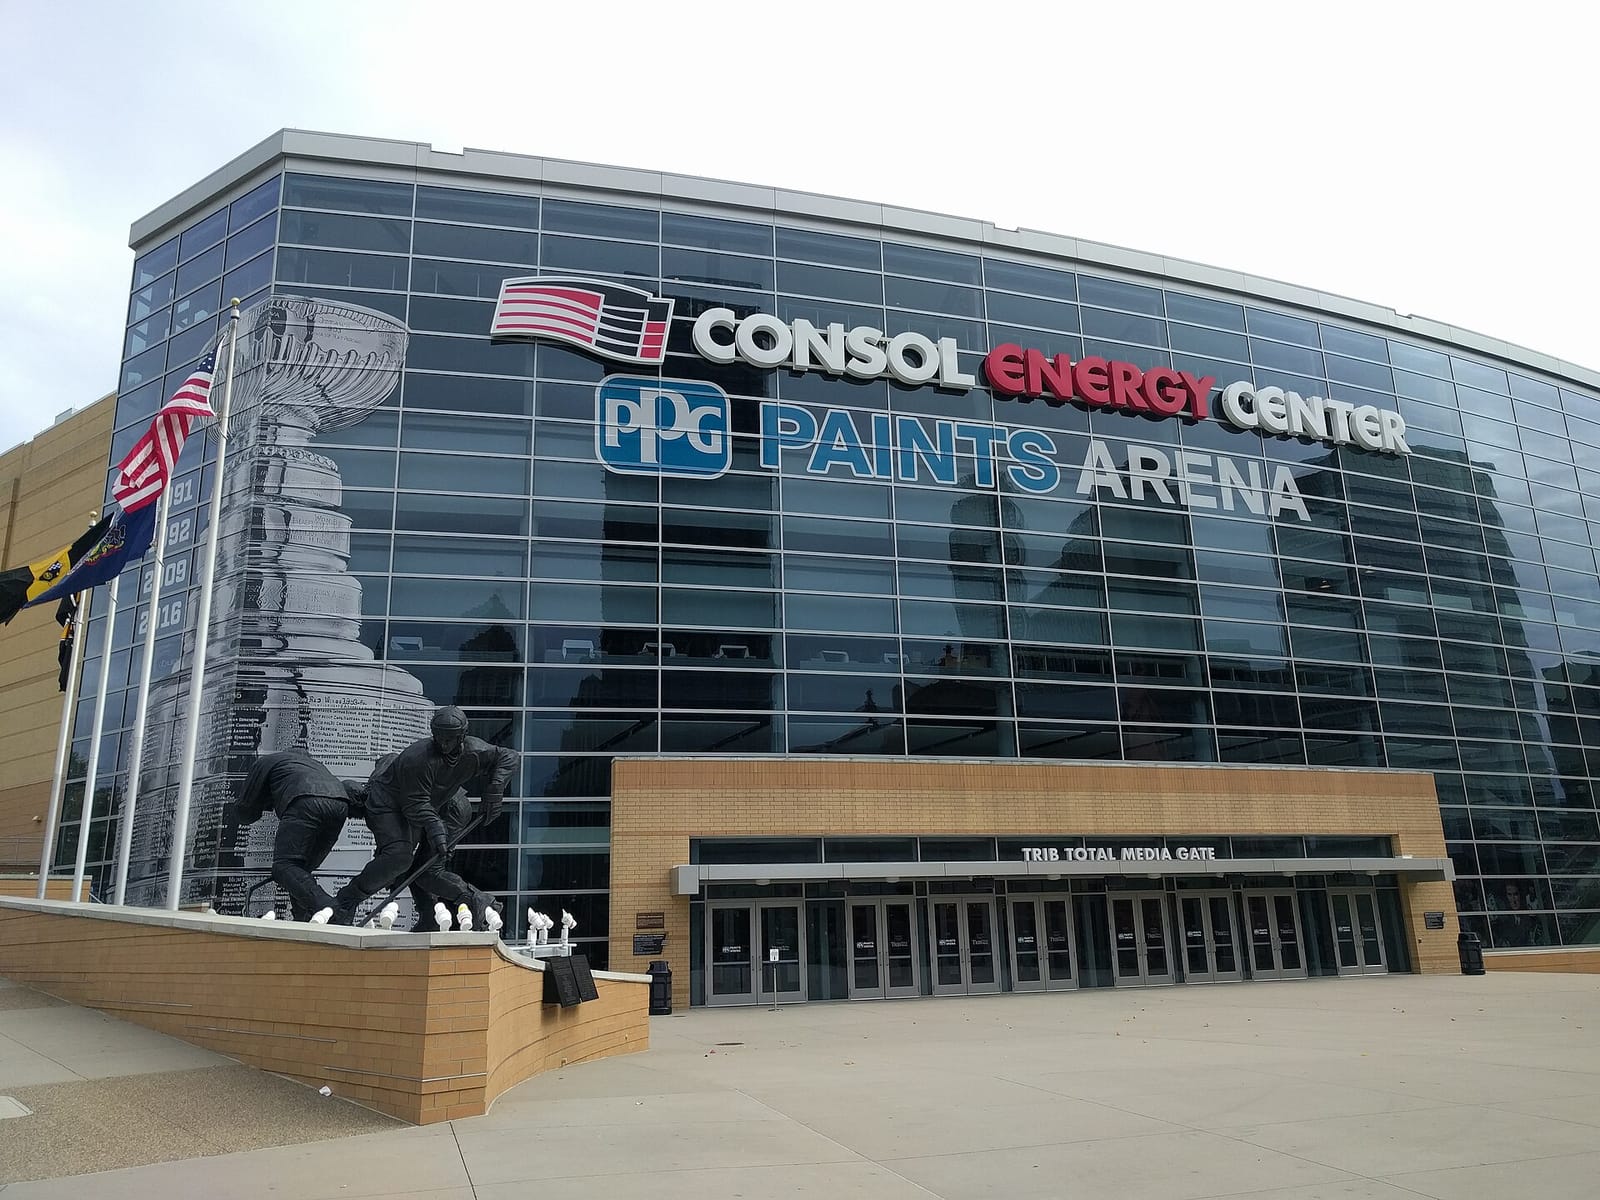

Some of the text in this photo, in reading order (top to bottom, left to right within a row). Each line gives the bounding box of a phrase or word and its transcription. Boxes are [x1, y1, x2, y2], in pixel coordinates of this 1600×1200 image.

[692, 307, 1411, 455] CONSOL ENERGY CENTER
[605, 388, 1311, 522] PPG PAINTS ARENA
[138, 601, 182, 635] 216
[1021, 846, 1216, 862] TRIB TOTAL MEDIA GATE
